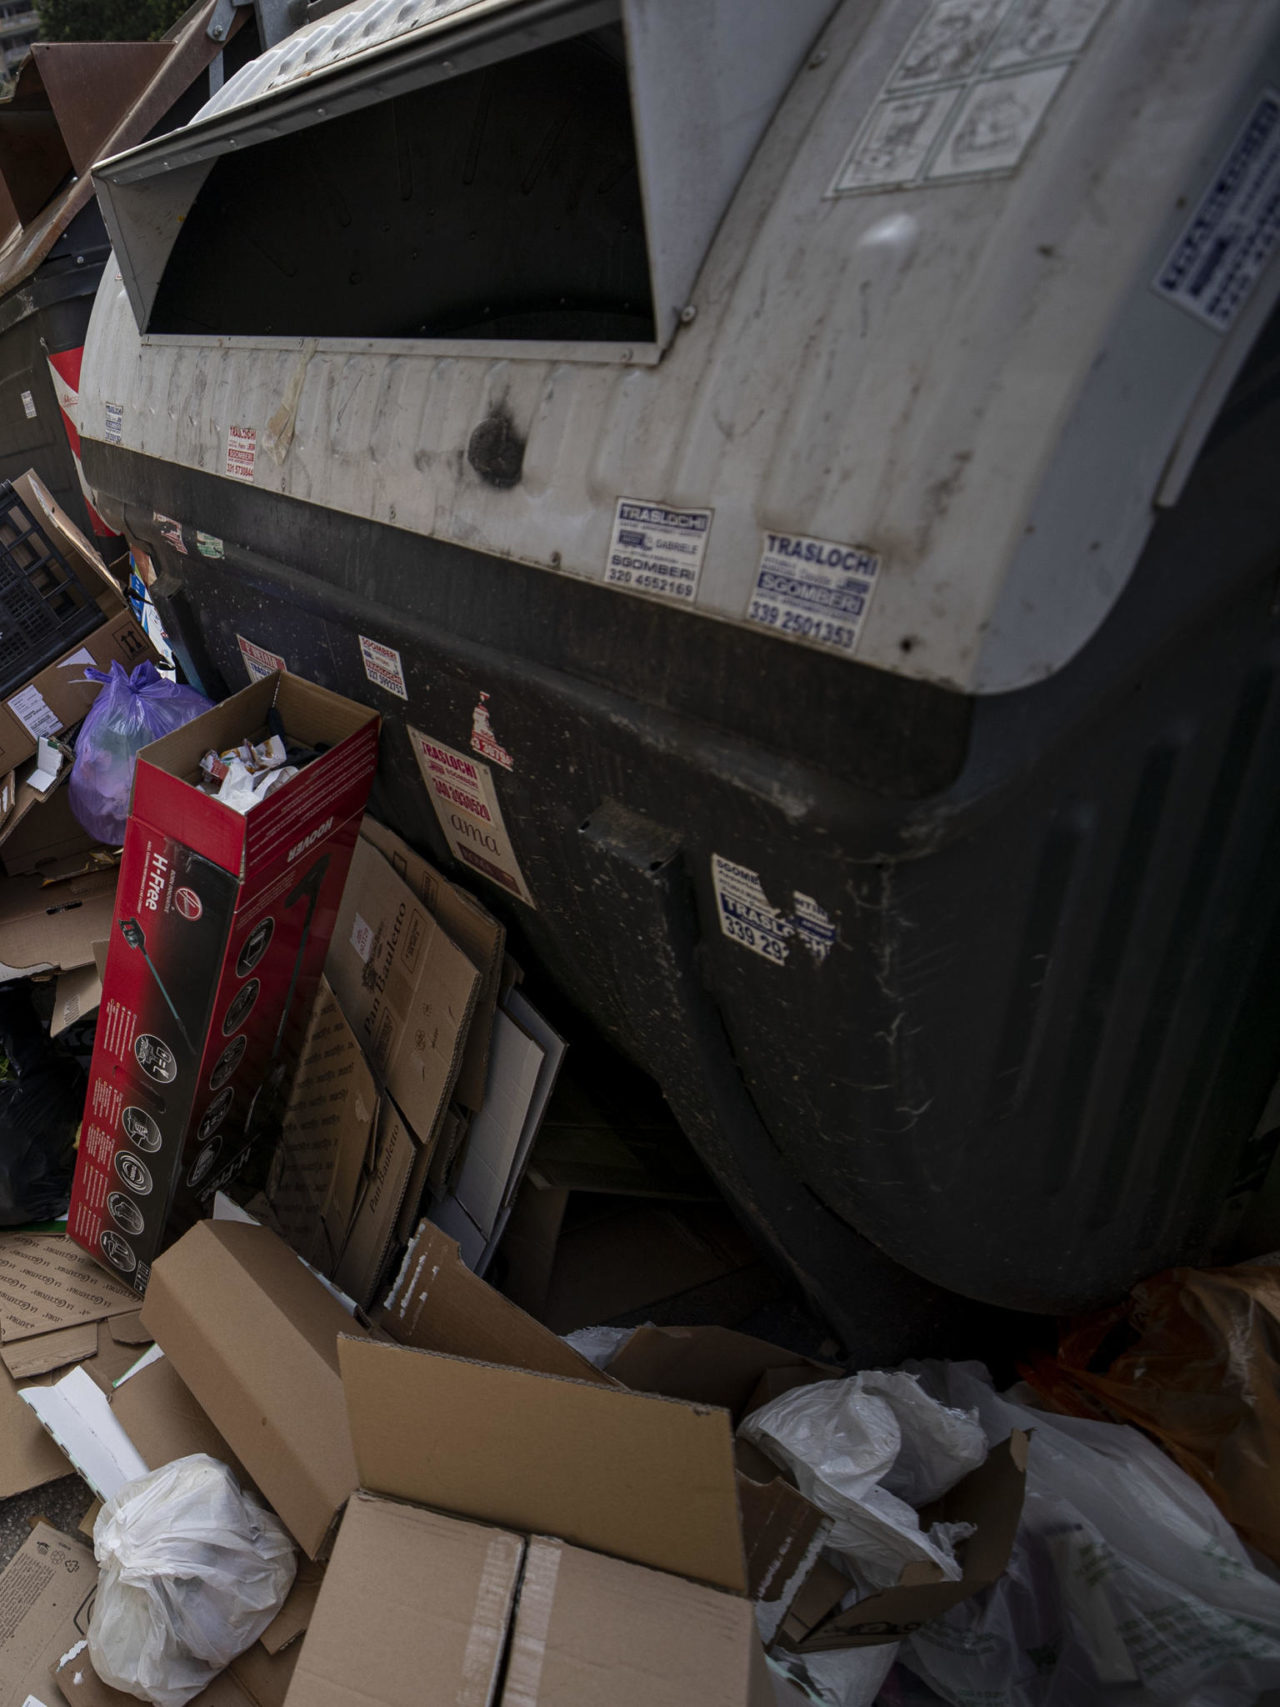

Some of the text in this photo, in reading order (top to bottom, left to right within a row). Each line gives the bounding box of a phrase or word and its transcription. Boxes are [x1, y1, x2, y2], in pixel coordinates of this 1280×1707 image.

[621, 505, 707, 530] TRASLOCHI
[611, 554, 696, 582] SGOMBERI
[767, 535, 879, 577] TRASLOCHI
[609, 568, 694, 597] 320 4552169
[762, 574, 863, 613] SGOMBERI
[750, 601, 779, 625] 339
[782, 611, 855, 649] 2501353
[421, 741, 478, 780] TRASLOCHI
[287, 816, 333, 863] HOOVER
[450, 813, 501, 857] ama
[145, 853, 168, 911] H-Free
[725, 916, 755, 946] 339
[364, 902, 407, 1034] Pan Bauletto
